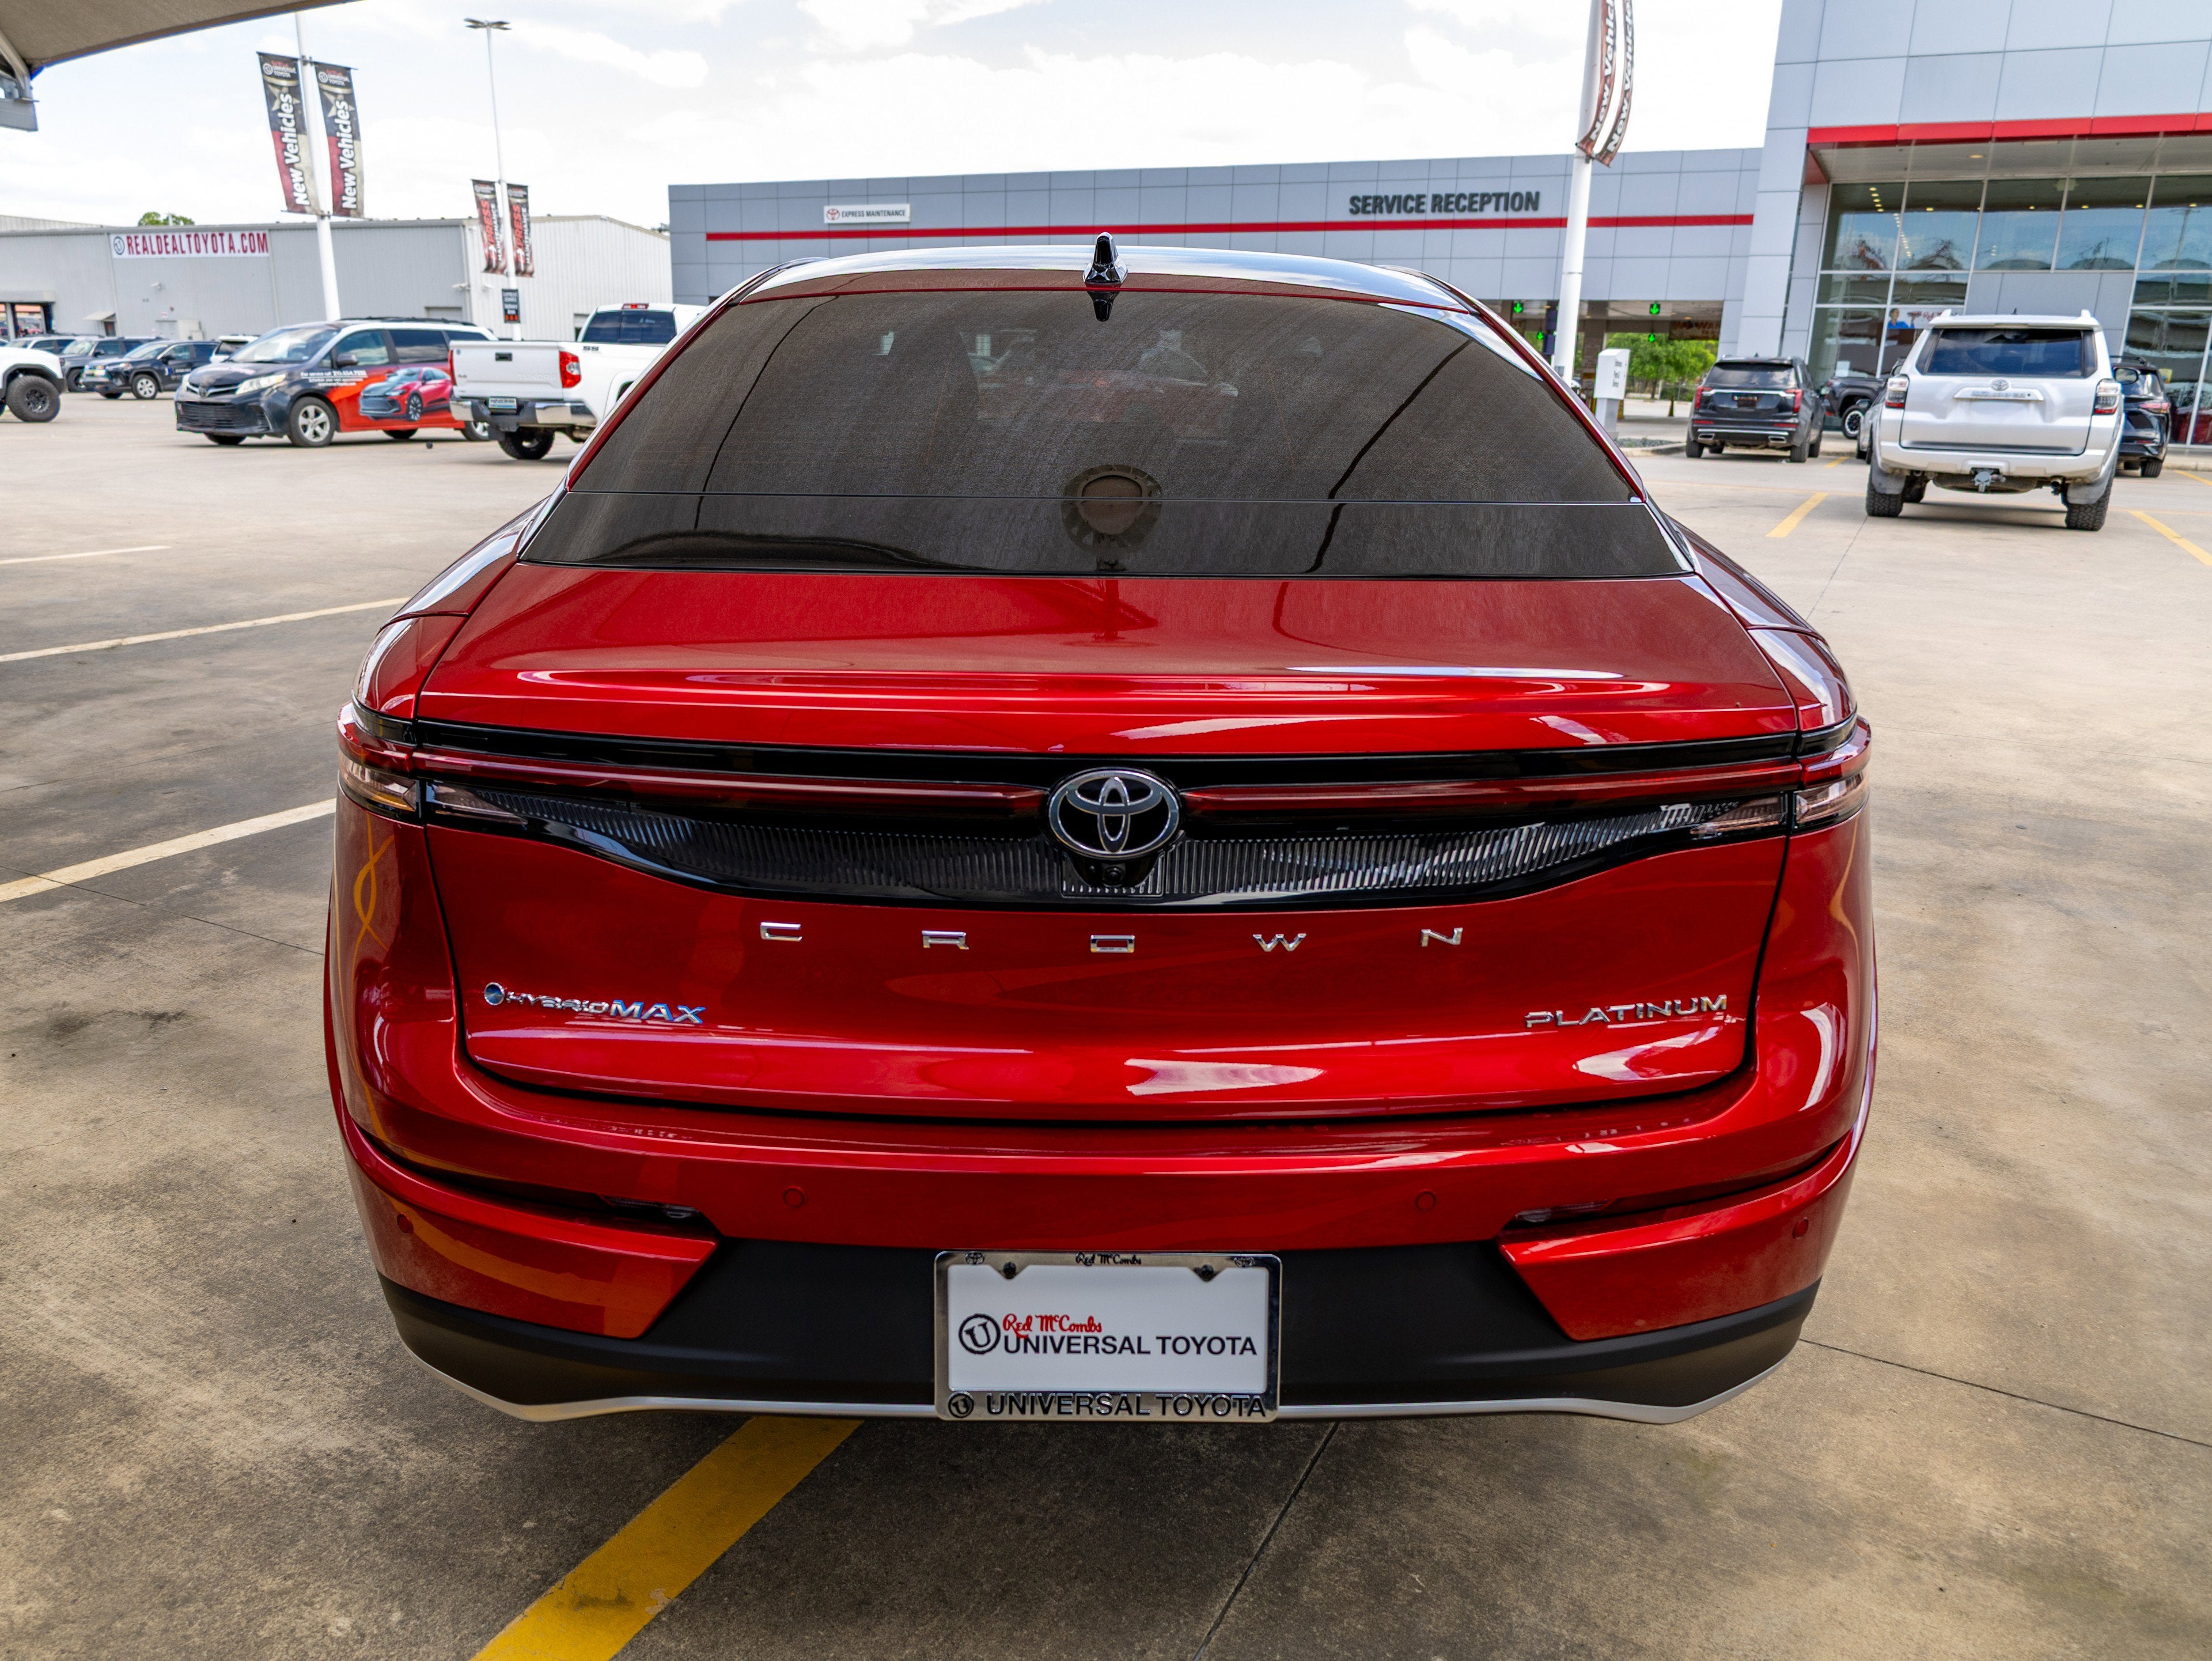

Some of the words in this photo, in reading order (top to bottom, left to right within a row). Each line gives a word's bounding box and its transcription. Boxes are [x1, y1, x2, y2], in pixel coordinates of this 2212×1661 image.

[277, 93, 301, 165] Vehicles
[1590, 84, 1610, 141] New
[1607, 98, 1628, 152] New
[334, 100, 355, 169] Vehicles
[290, 168, 310, 205] New
[342, 172, 357, 209] New
[1349, 194, 1426, 214] SERVICE
[1431, 191, 1540, 213] RECEPTION
[126, 233, 269, 255] REALDEALTOYOTA.COM
[491, 203, 502, 262] MAINTENANCE
[522, 207, 531, 264] MAINTENANCE
[760, 921, 1463, 952] CROWN
[1525, 994, 1728, 1028] PLATINUM
[1075, 1251, 1096, 1266] Red
[1097, 1253, 1142, 1265] McCombs
[1002, 1313, 1033, 1338] Red
[1035, 1314, 1103, 1333] McCombs
[1004, 1334, 1151, 1355] UNIVERSAL
[1156, 1335, 1258, 1356] TOYOTA
[986, 1393, 1151, 1416] UNIVERSAL
[1154, 1393, 1266, 1417] TOYOTA
